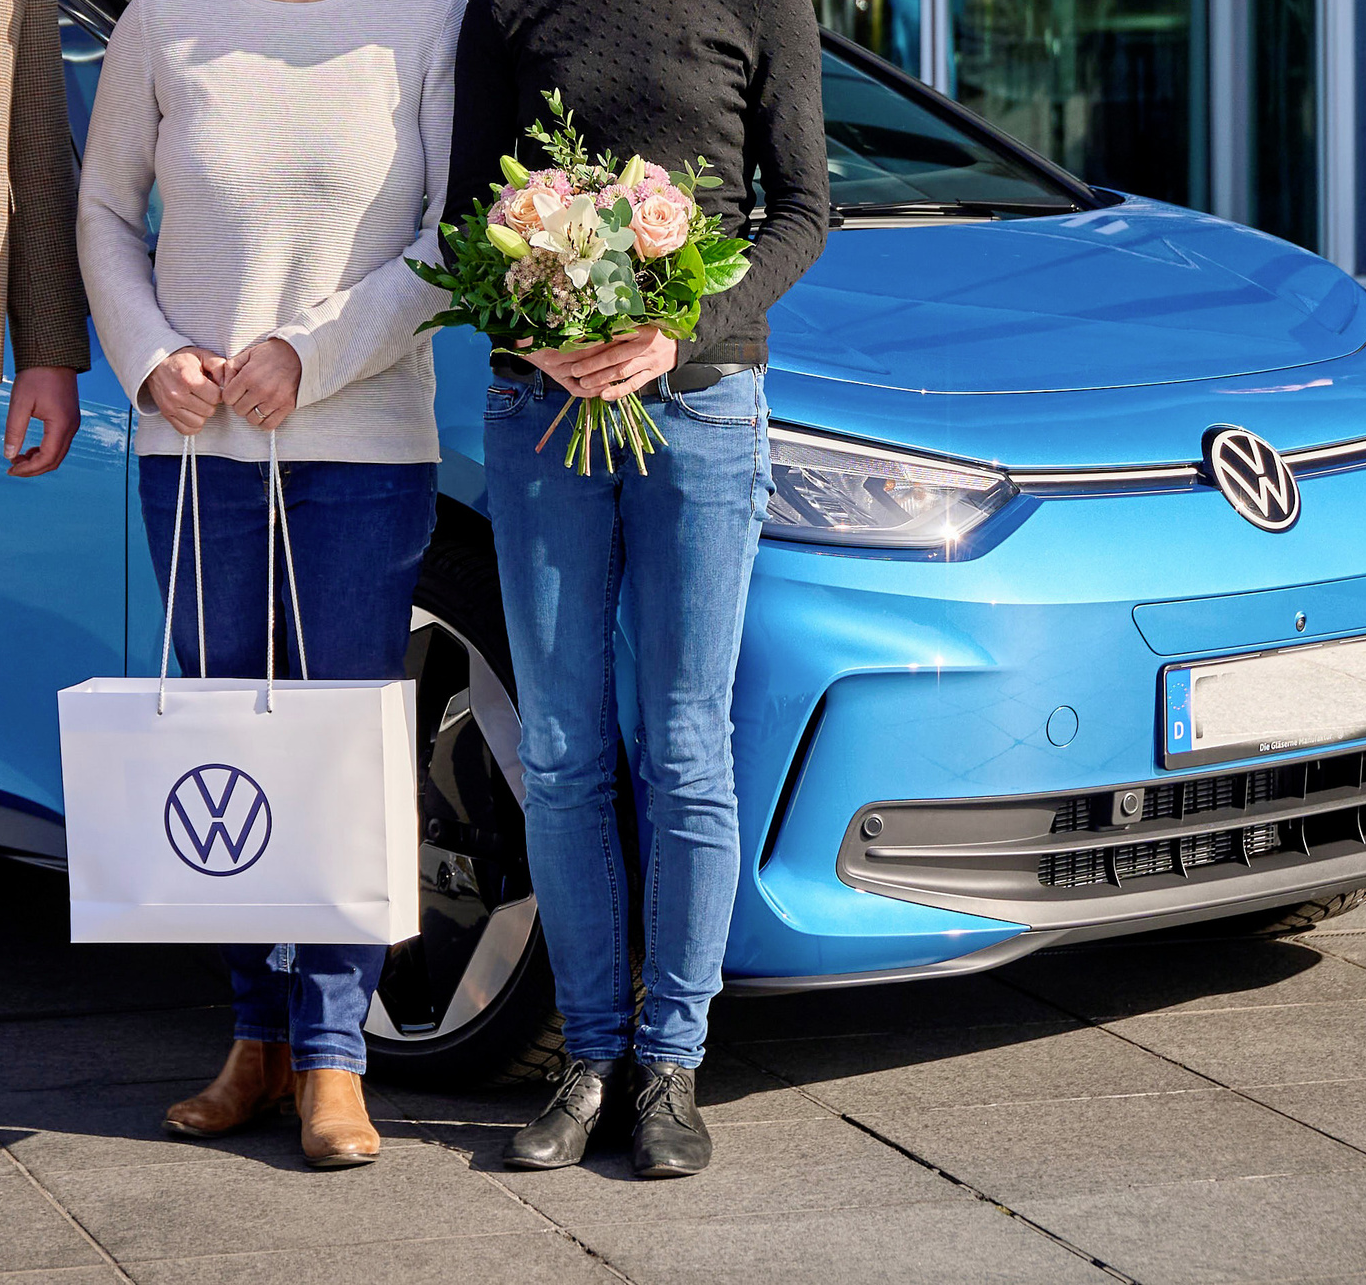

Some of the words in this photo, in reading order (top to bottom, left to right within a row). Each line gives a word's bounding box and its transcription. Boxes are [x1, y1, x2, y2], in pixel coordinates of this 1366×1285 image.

[1174, 721, 1184, 740] D
[1259, 742, 1270, 752] Die
[1271, 740, 1298, 750] Gläserne
